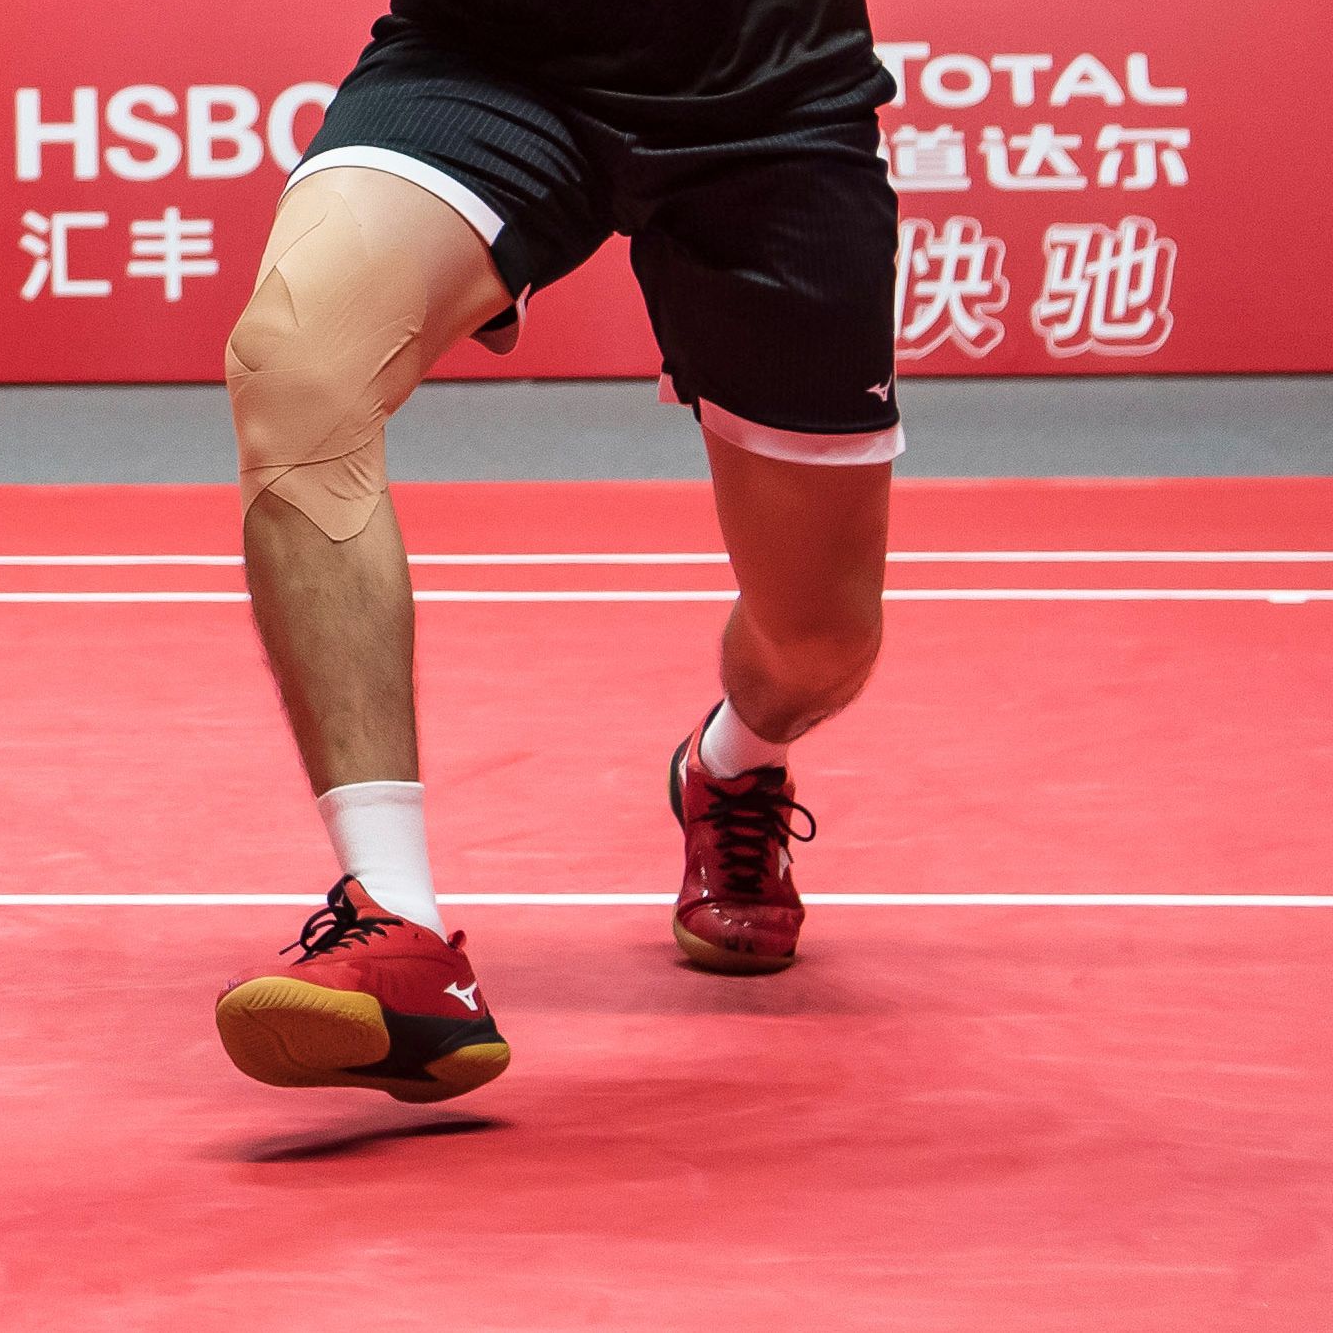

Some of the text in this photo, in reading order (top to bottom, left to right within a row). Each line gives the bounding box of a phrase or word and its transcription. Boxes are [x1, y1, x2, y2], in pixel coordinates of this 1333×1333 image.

[873, 41, 1188, 107] TOTAL
[880, 124, 1191, 193] 道达尔
[18, 206, 220, 303] 汇丰
